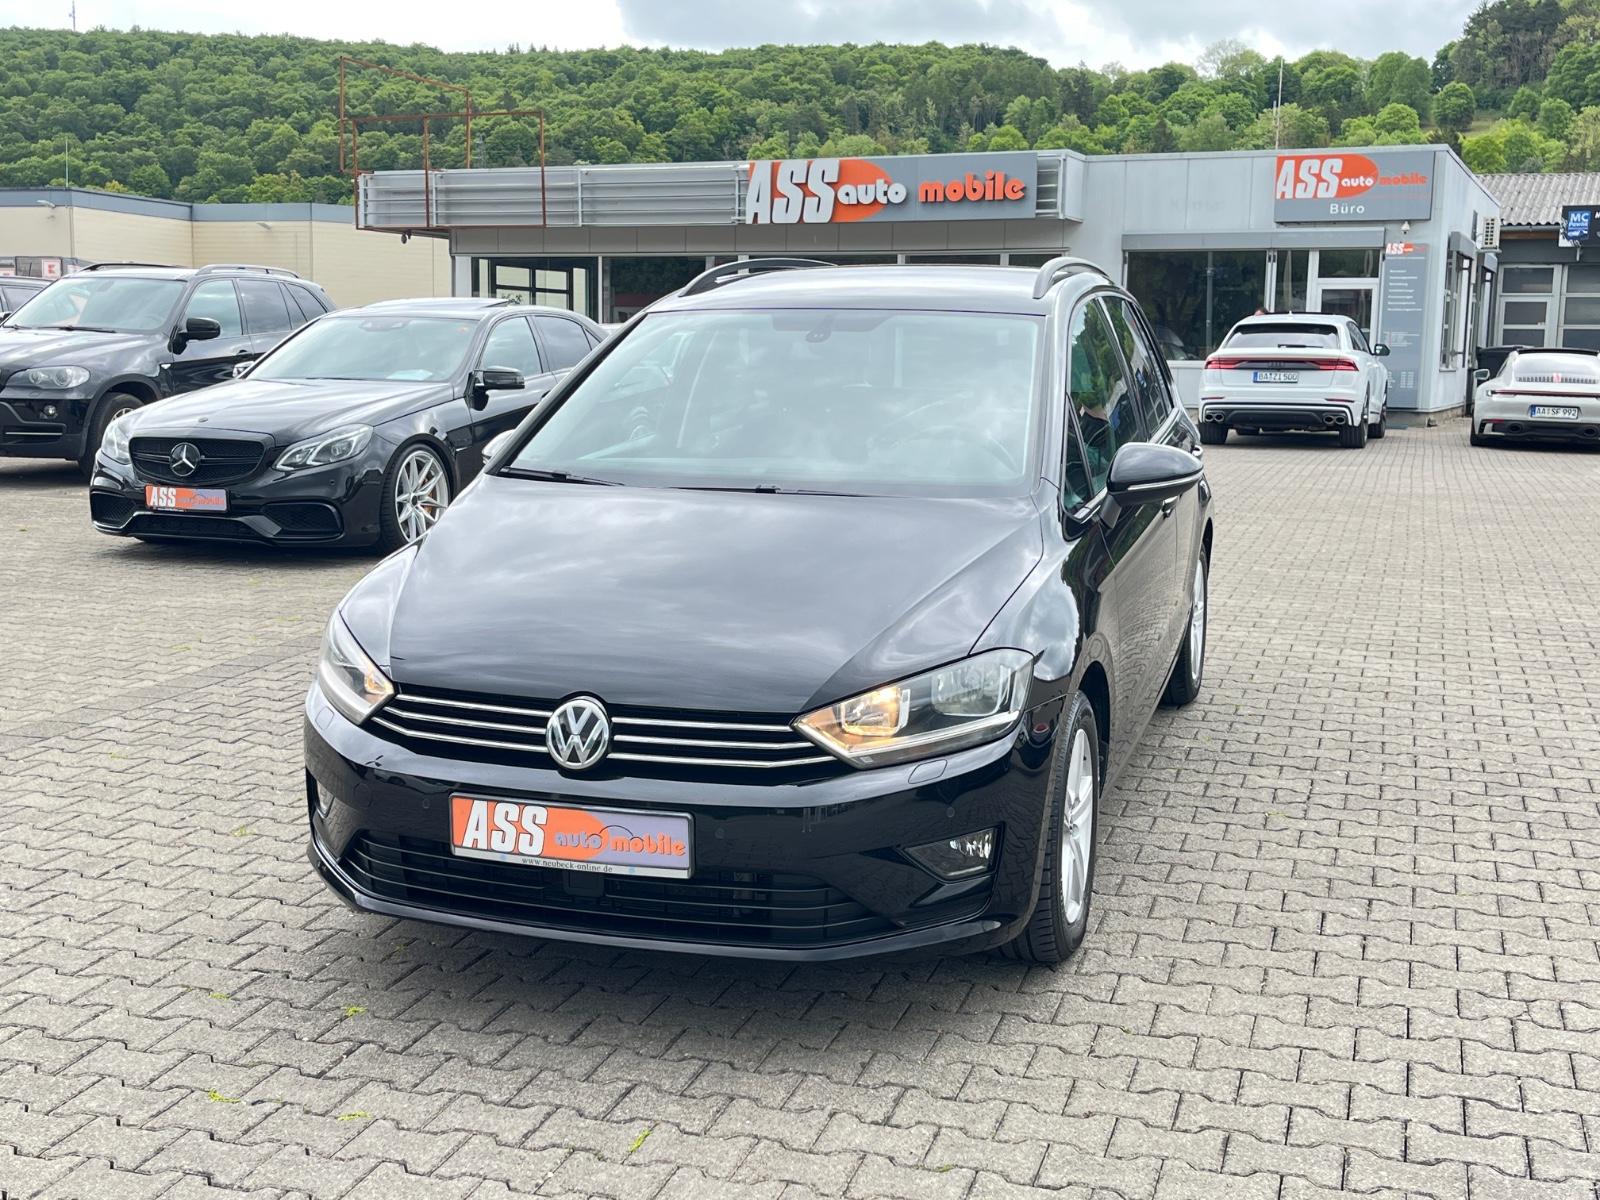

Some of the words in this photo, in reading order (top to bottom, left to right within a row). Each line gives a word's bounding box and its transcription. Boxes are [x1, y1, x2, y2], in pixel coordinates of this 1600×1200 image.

[1276, 158, 1343, 200] ASS
[1341, 175, 1374, 187] auto
[746, 159, 840, 225] ASS
[837, 178, 907, 205] auto
[918, 169, 1026, 203] mobile
[1329, 203, 1365, 214] Büro
[1570, 212, 1589, 222] MC
[1385, 243, 1405, 255] ASS
[1562, 408, 1577, 417] 992
[150, 486, 177, 507] ASS
[461, 800, 548, 856] ASS
[555, 830, 604, 849] auto
[611, 834, 687, 857] mobile
[521, 856, 613, 874] www.neubeck-online.de
